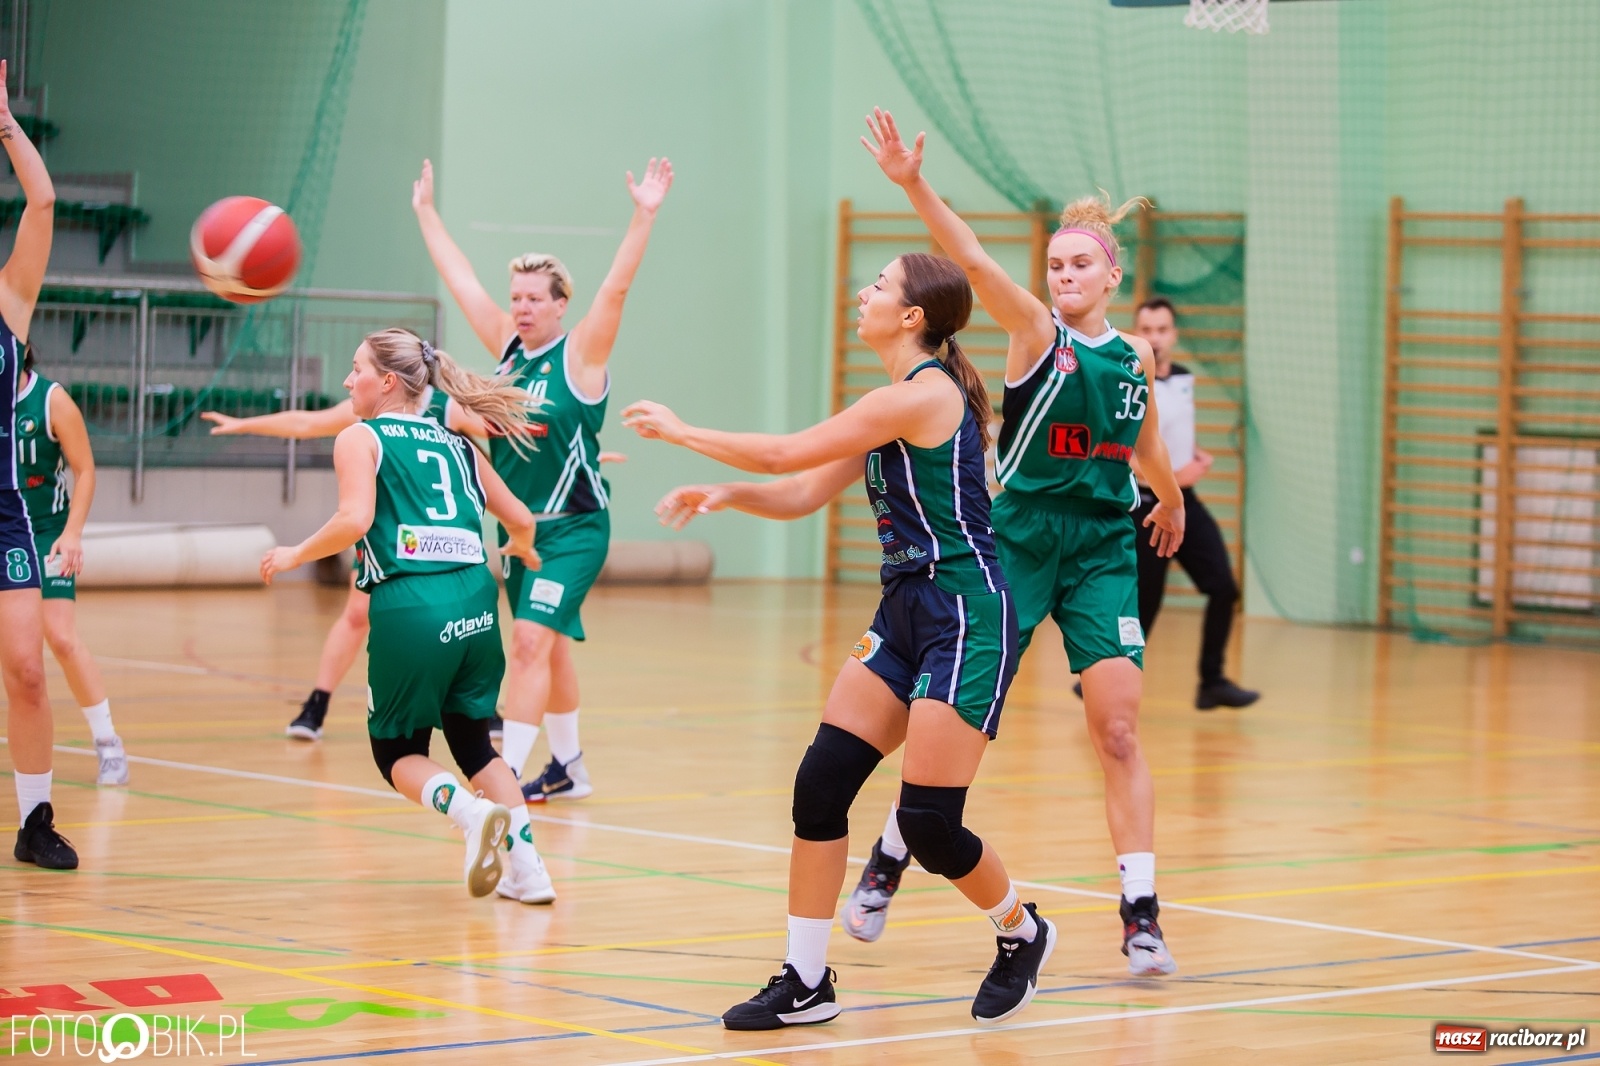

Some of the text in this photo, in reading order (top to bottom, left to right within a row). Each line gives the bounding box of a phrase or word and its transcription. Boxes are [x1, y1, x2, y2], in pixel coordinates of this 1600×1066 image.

[1115, 382, 1149, 420] 35
[380, 424, 409, 438] RKK
[1052, 426, 1087, 457] K
[18, 438, 37, 465] 11
[417, 449, 457, 520] 3
[867, 452, 888, 494] 4
[419, 532, 466, 544] wydawnictwo
[419, 540, 481, 558] WAGTECH
[6, 548, 31, 582] 8
[453, 610, 494, 638] Clavis
